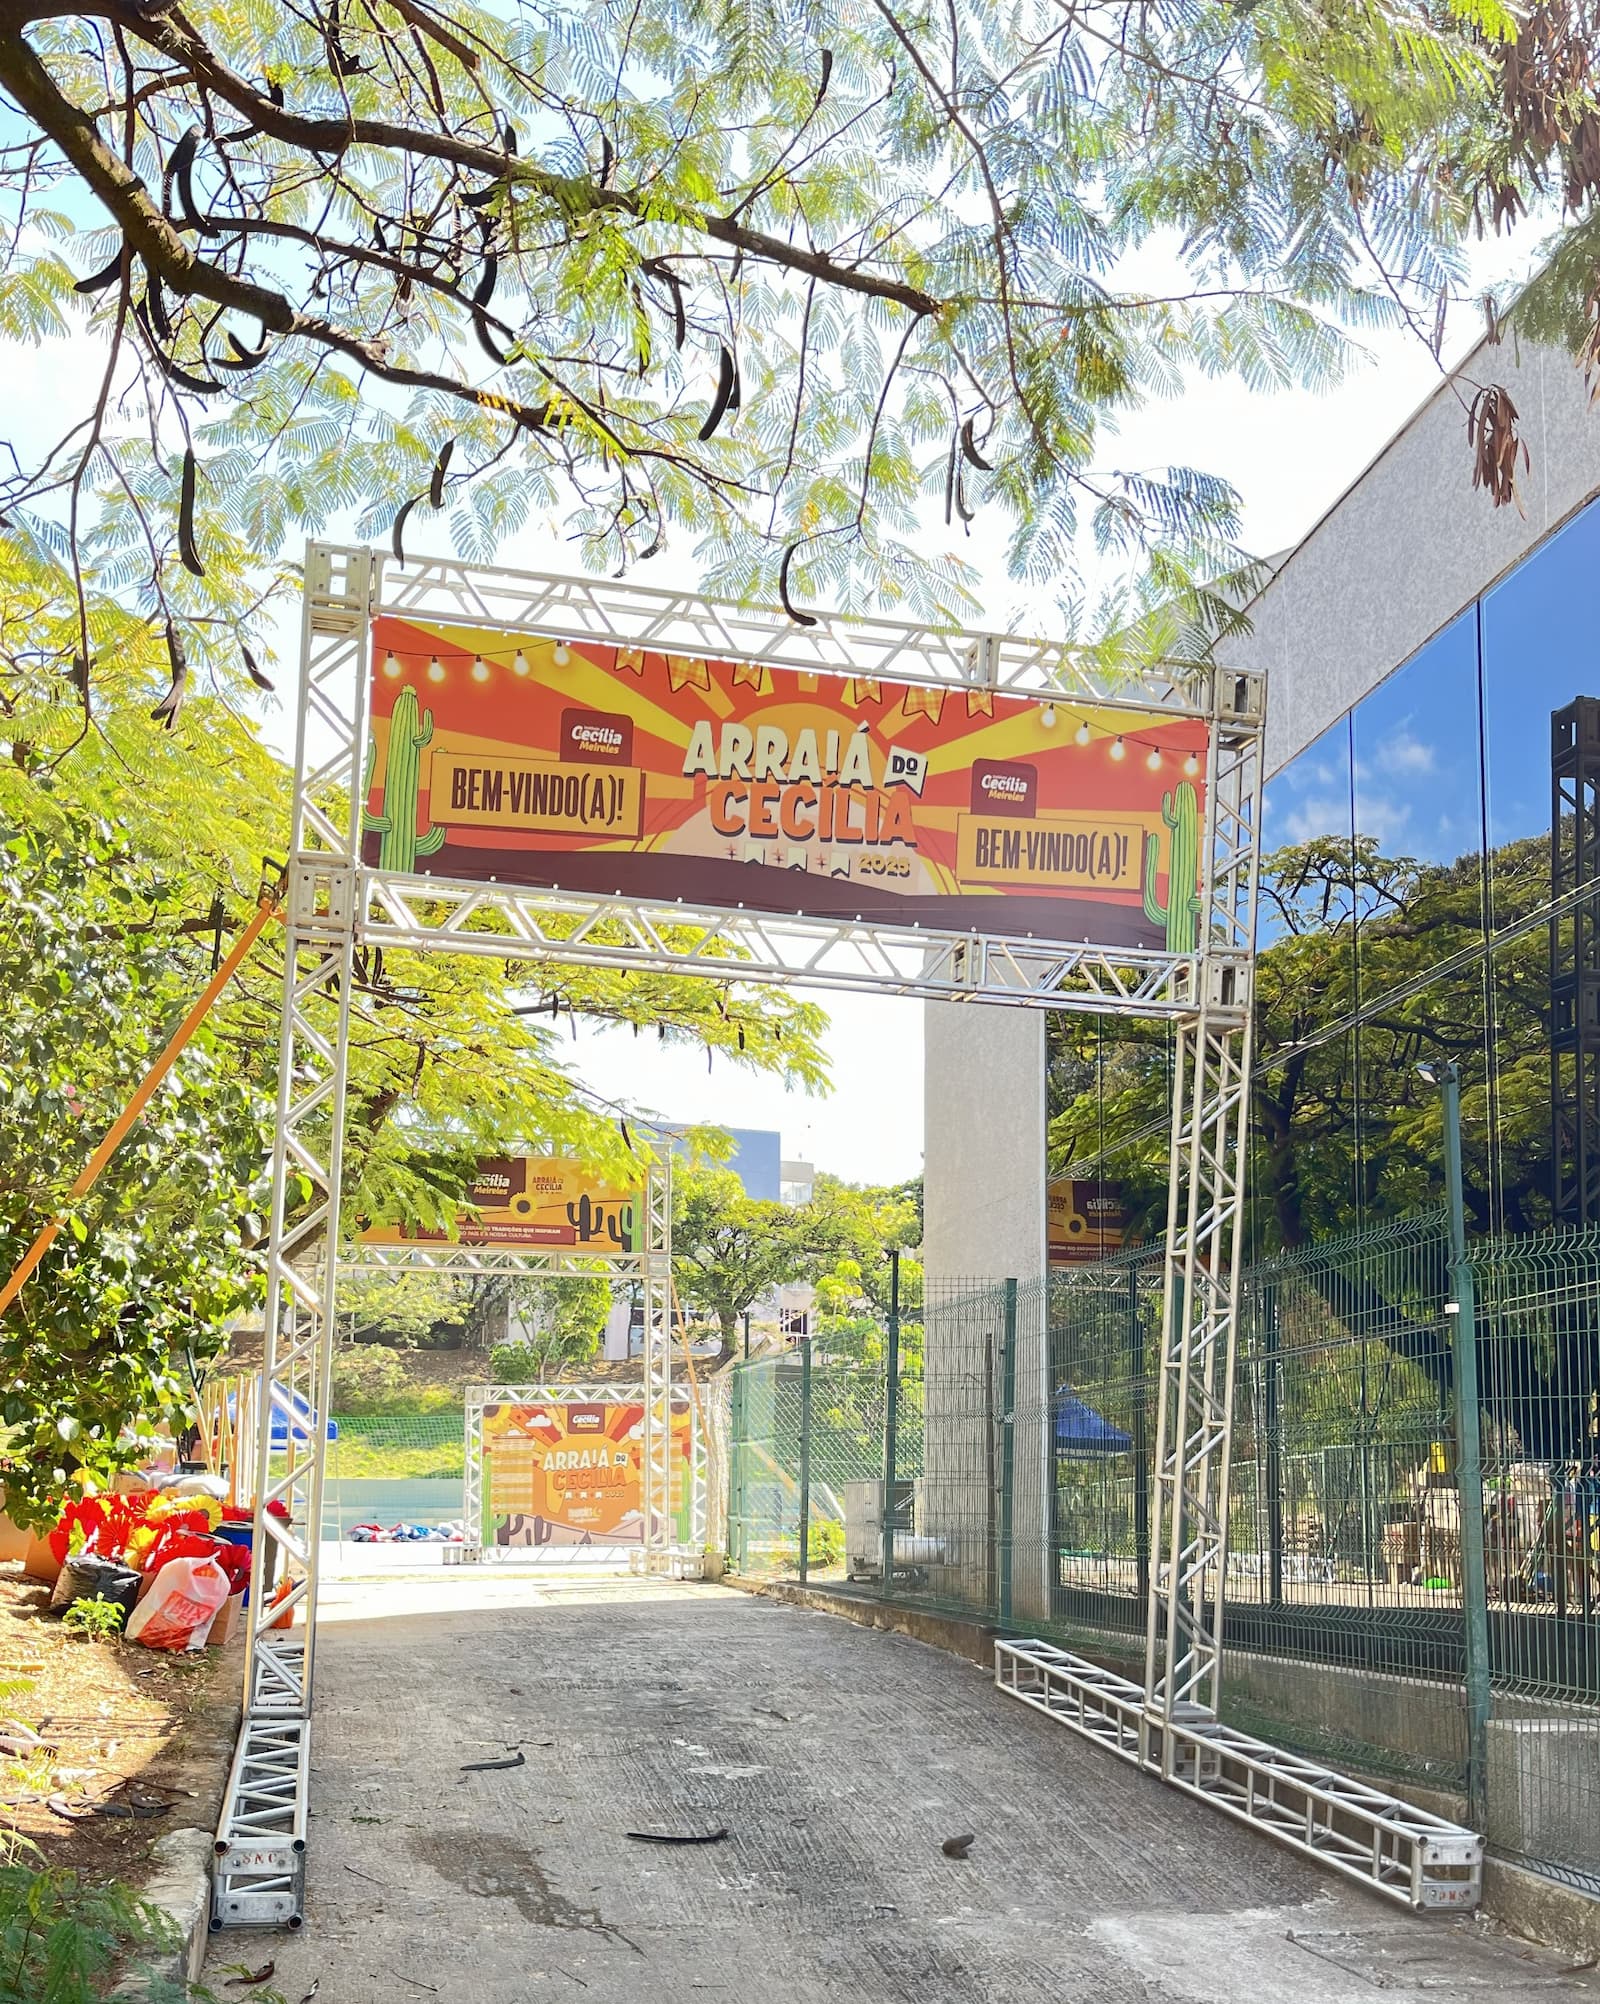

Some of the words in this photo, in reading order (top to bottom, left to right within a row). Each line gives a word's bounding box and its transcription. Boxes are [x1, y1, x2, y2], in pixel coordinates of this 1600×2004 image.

[571, 725, 623, 745] Cecília
[578, 741, 620, 754] Meireles
[682, 719, 875, 790] ARRAIÁ
[981, 774, 1028, 793] Cecília
[988, 790, 1025, 802] Meireles
[451, 767, 625, 826] BEM-VINDO(A)!
[709, 775, 918, 847] CECÍLIA
[858, 853, 912, 878] 2025
[975, 827, 1129, 881] BEM-VINDO(A)!
[473, 1186, 509, 1195] Meireles
[543, 1444, 610, 1471] ARRAIÁ
[553, 1465, 627, 1491] CECÍLIA
[174, 1599, 206, 1619] MIX
